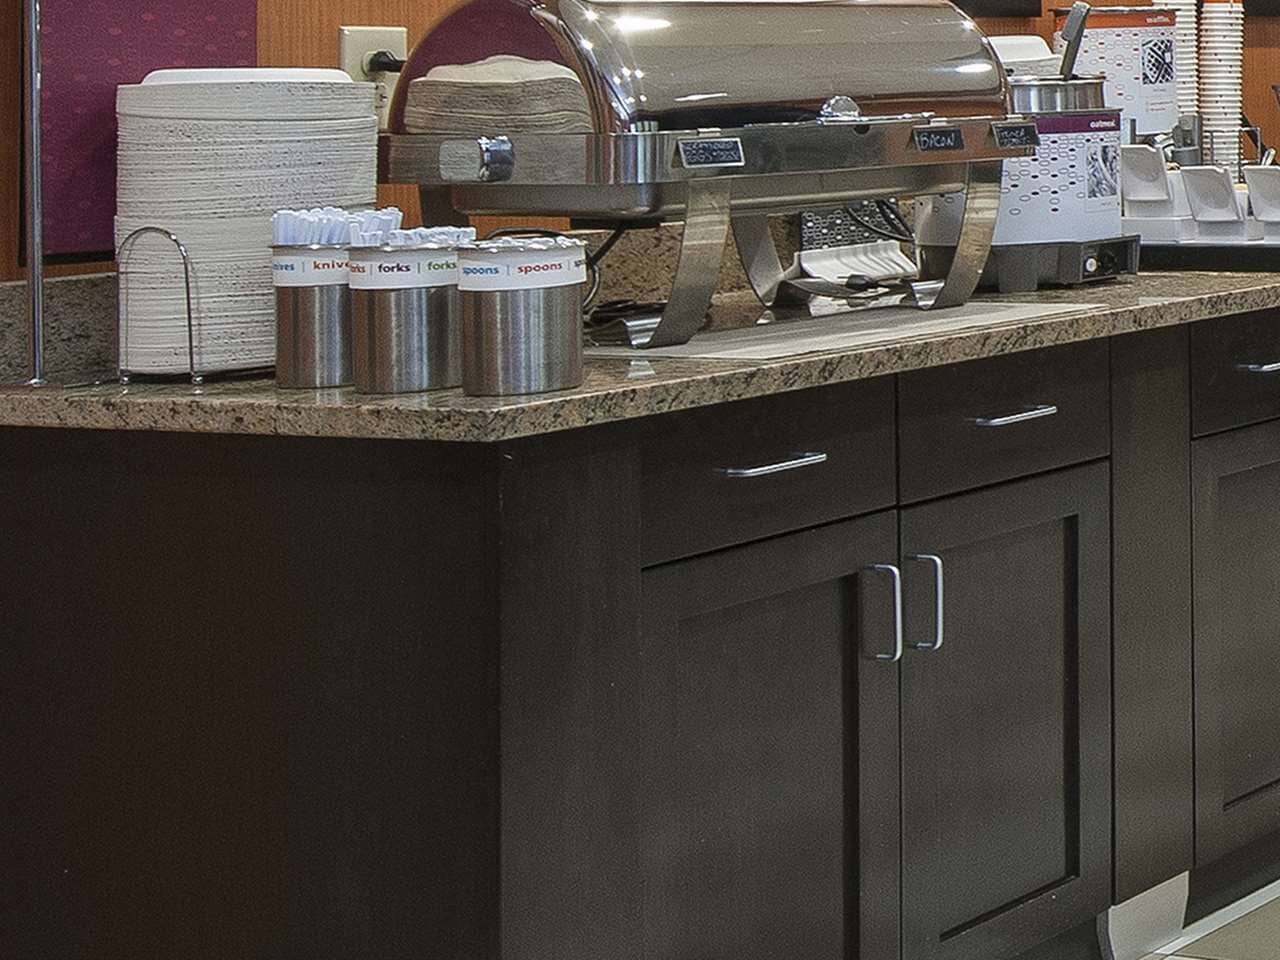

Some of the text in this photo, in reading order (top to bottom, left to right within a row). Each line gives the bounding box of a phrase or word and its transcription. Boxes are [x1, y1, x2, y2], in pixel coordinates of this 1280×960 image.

[920, 131, 956, 149] BACON
[313, 260, 350, 271] knive
[378, 263, 411, 273] forks
[428, 261, 457, 271] forks
[463, 265, 499, 276] spoons
[517, 262, 563, 275] spoons
